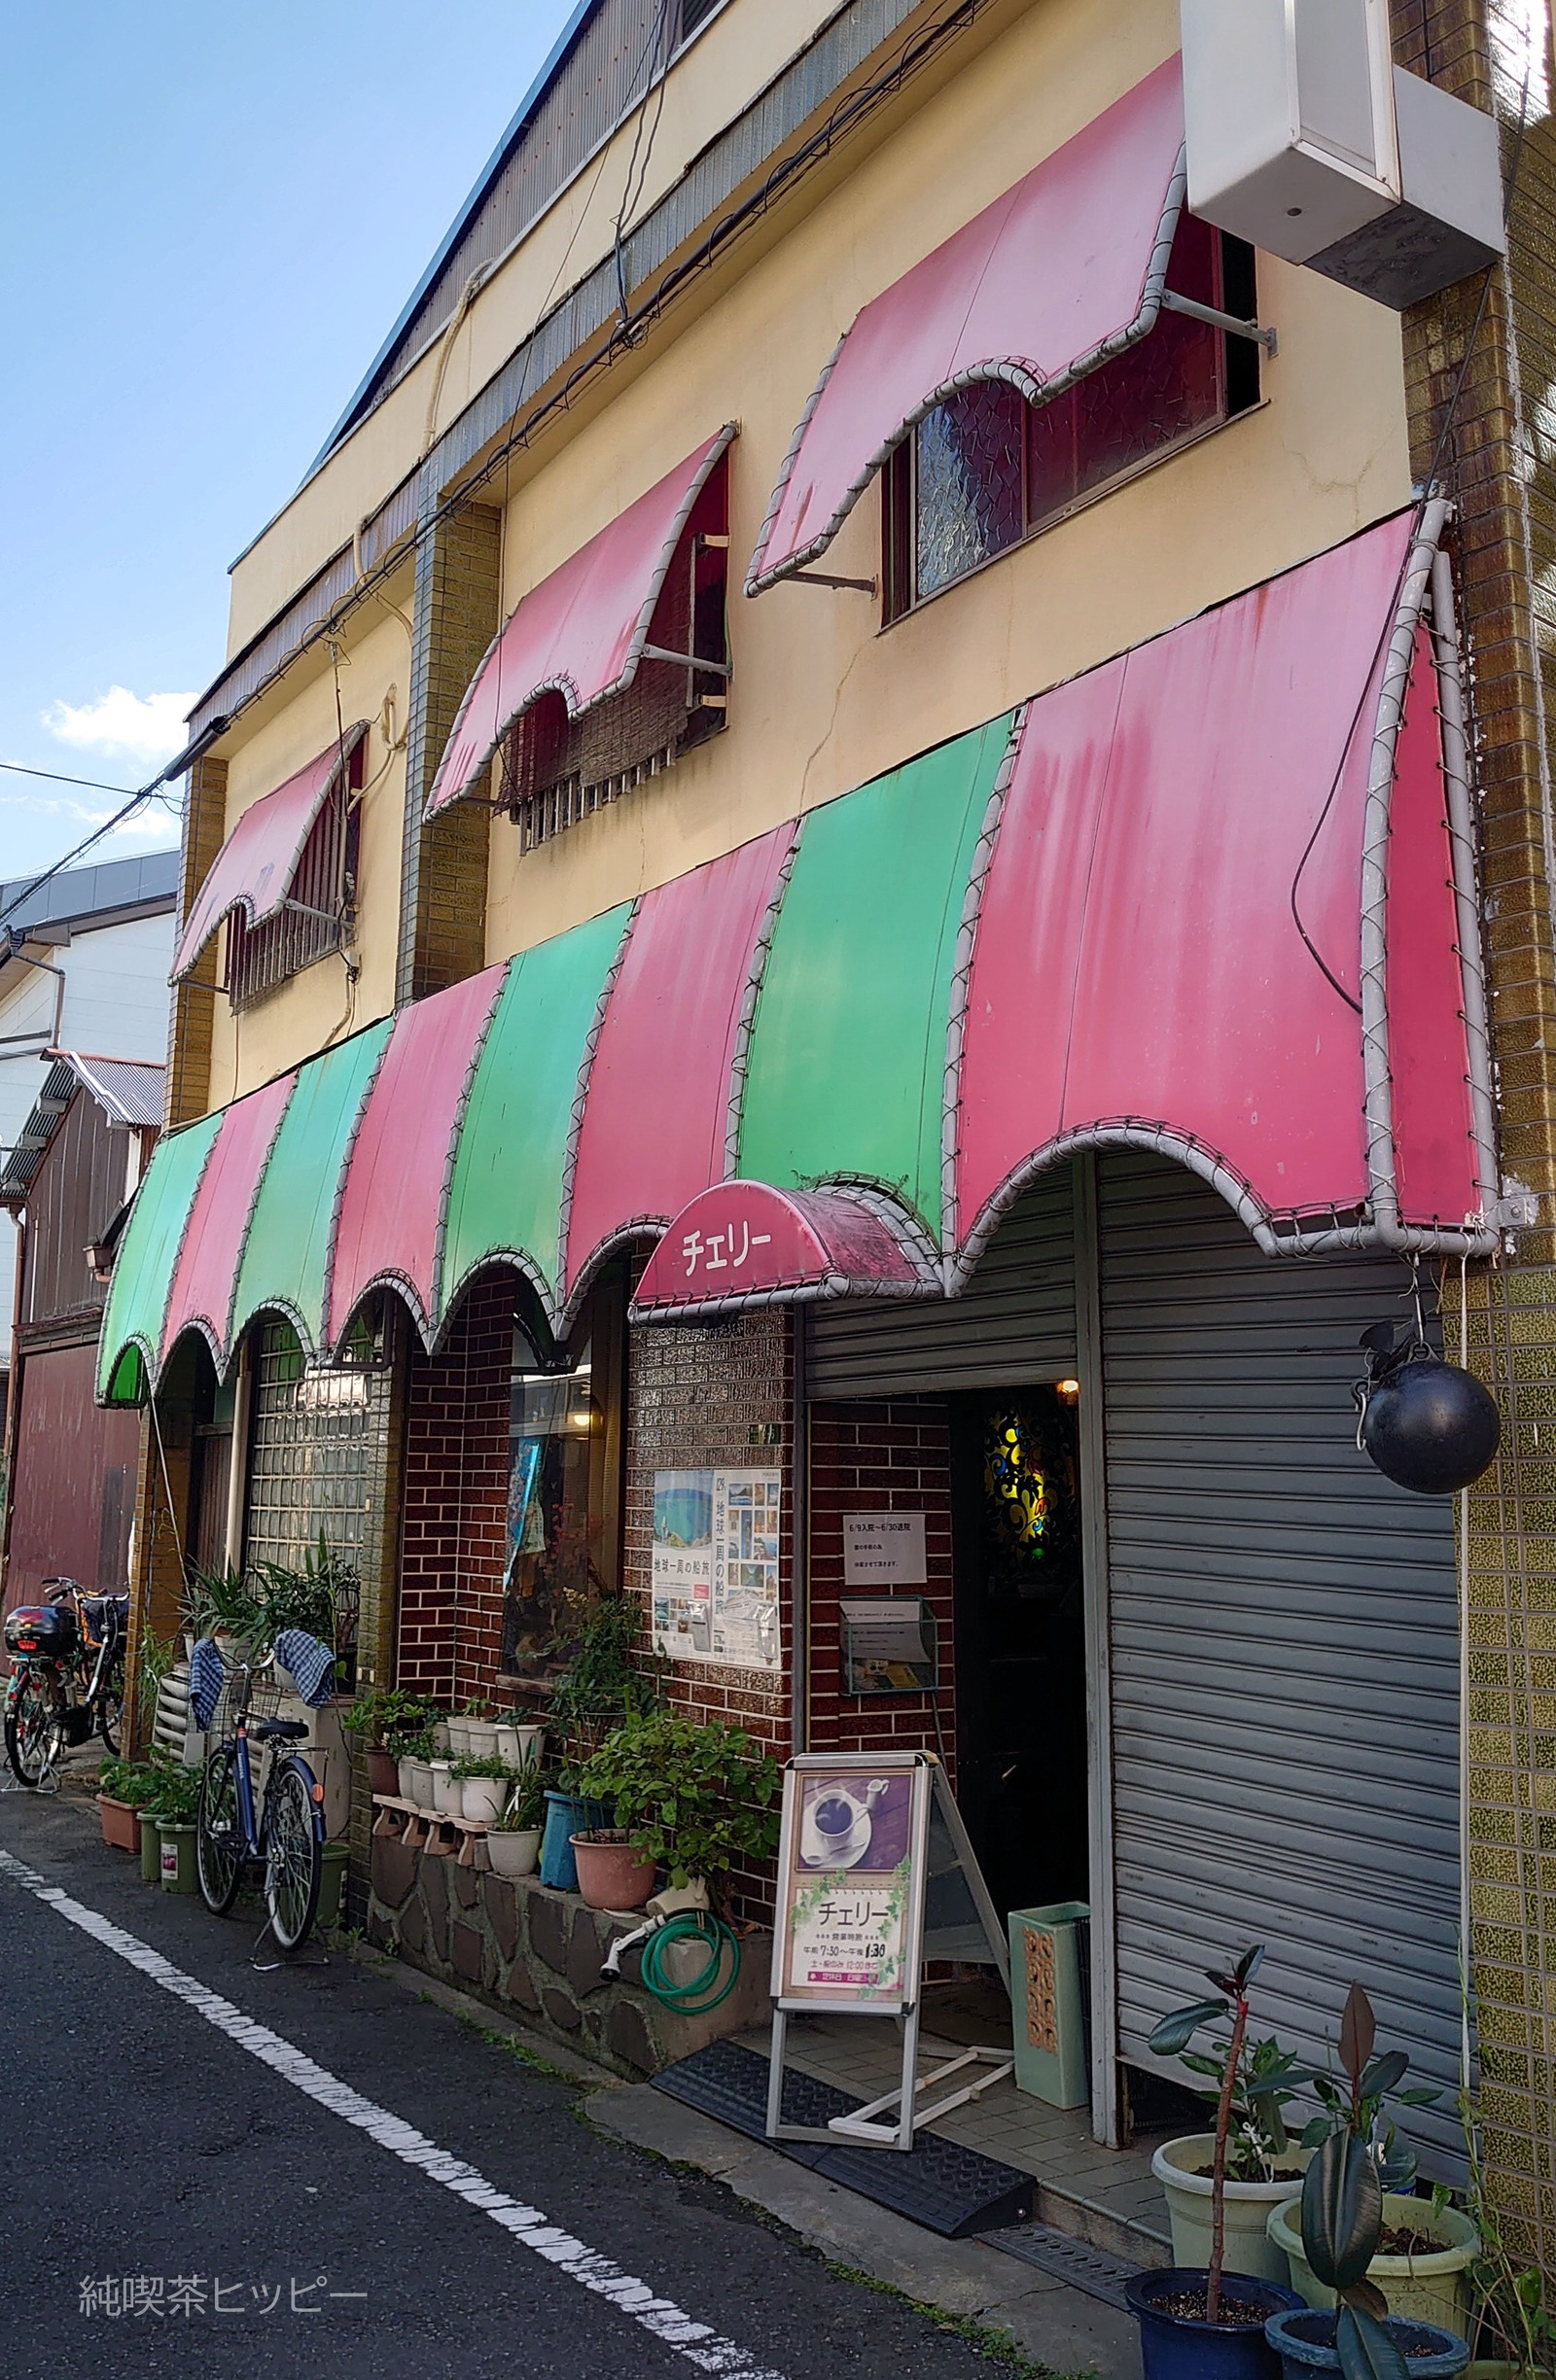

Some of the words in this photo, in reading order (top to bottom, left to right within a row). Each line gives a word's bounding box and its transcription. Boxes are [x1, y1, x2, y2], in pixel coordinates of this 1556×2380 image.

[682, 1220, 772, 1277] チェリー
[654, 1558, 710, 1575] 地球一周の船旅
[819, 1902, 889, 1926] チェリー
